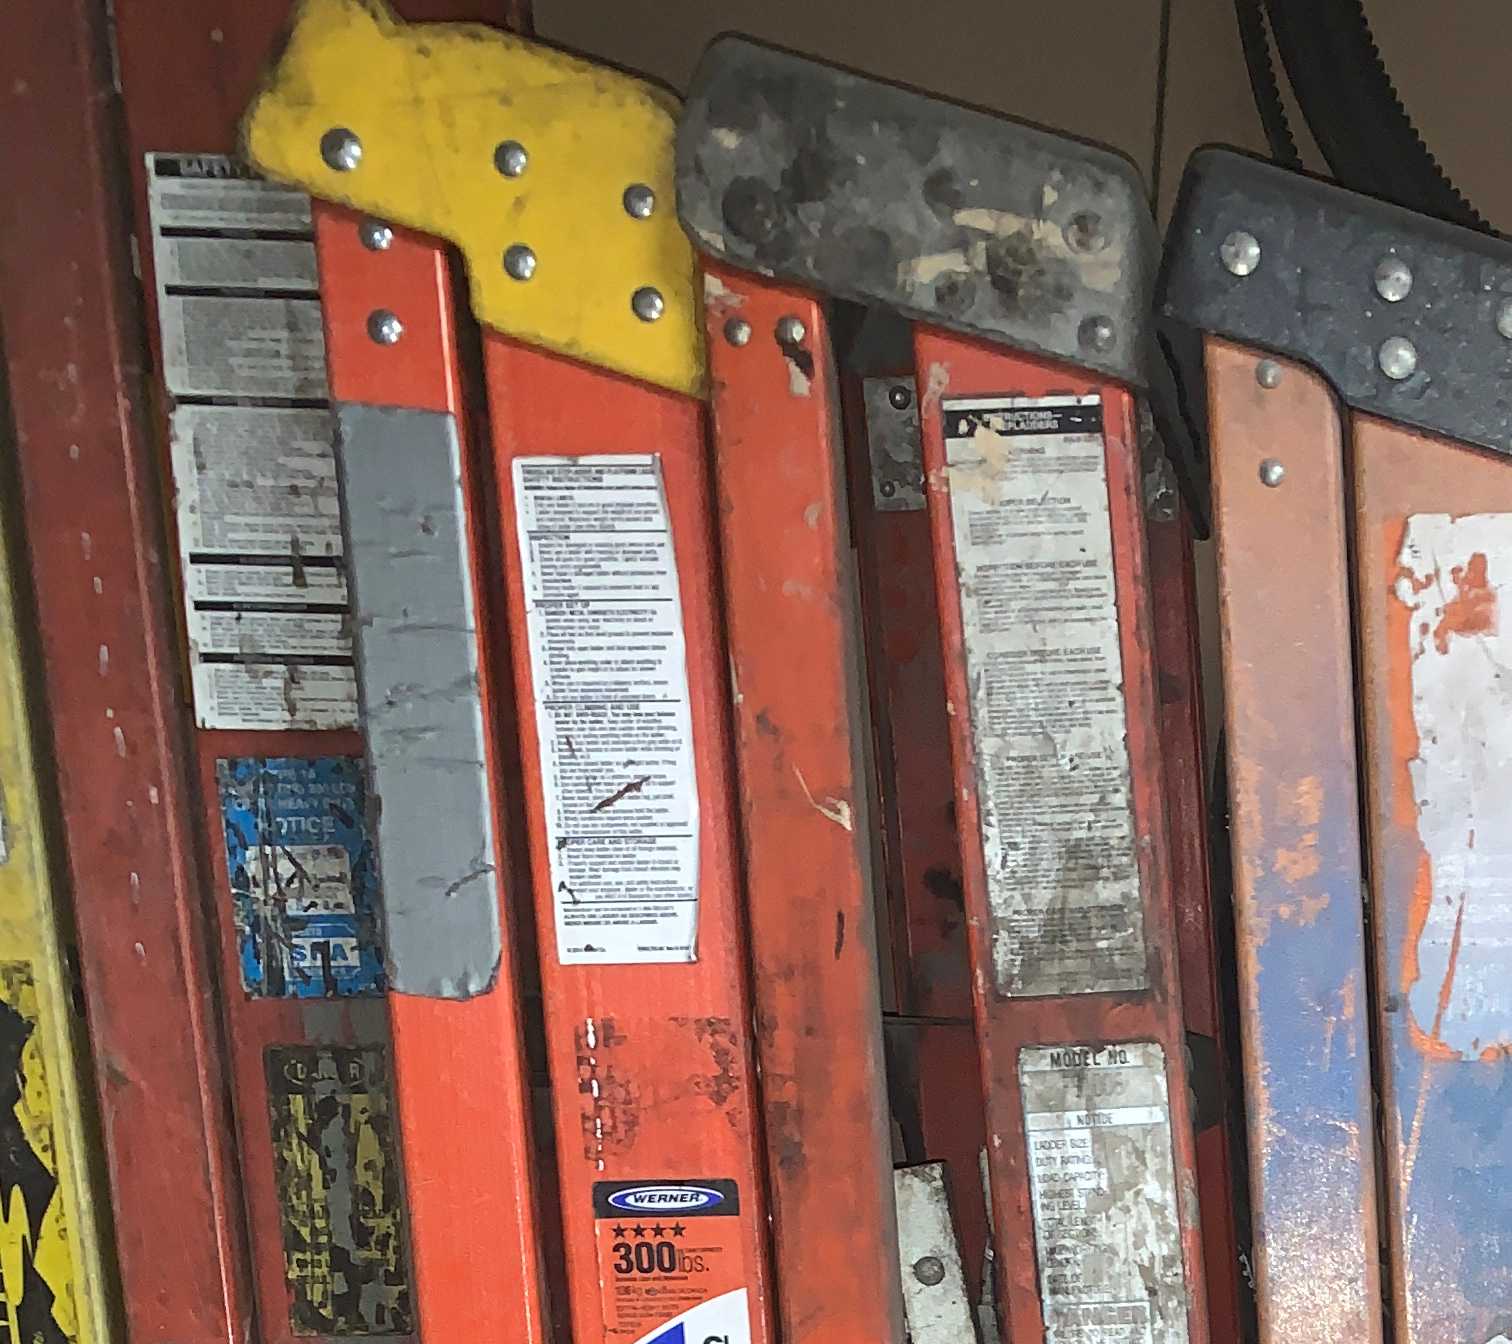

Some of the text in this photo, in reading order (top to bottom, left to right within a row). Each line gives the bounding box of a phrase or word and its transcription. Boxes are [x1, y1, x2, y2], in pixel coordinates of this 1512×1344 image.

[1050, 1051, 1099, 1068] MODEL
[633, 1192, 700, 1204] WERNER
[613, 1241, 710, 1275] 300 lbs.
